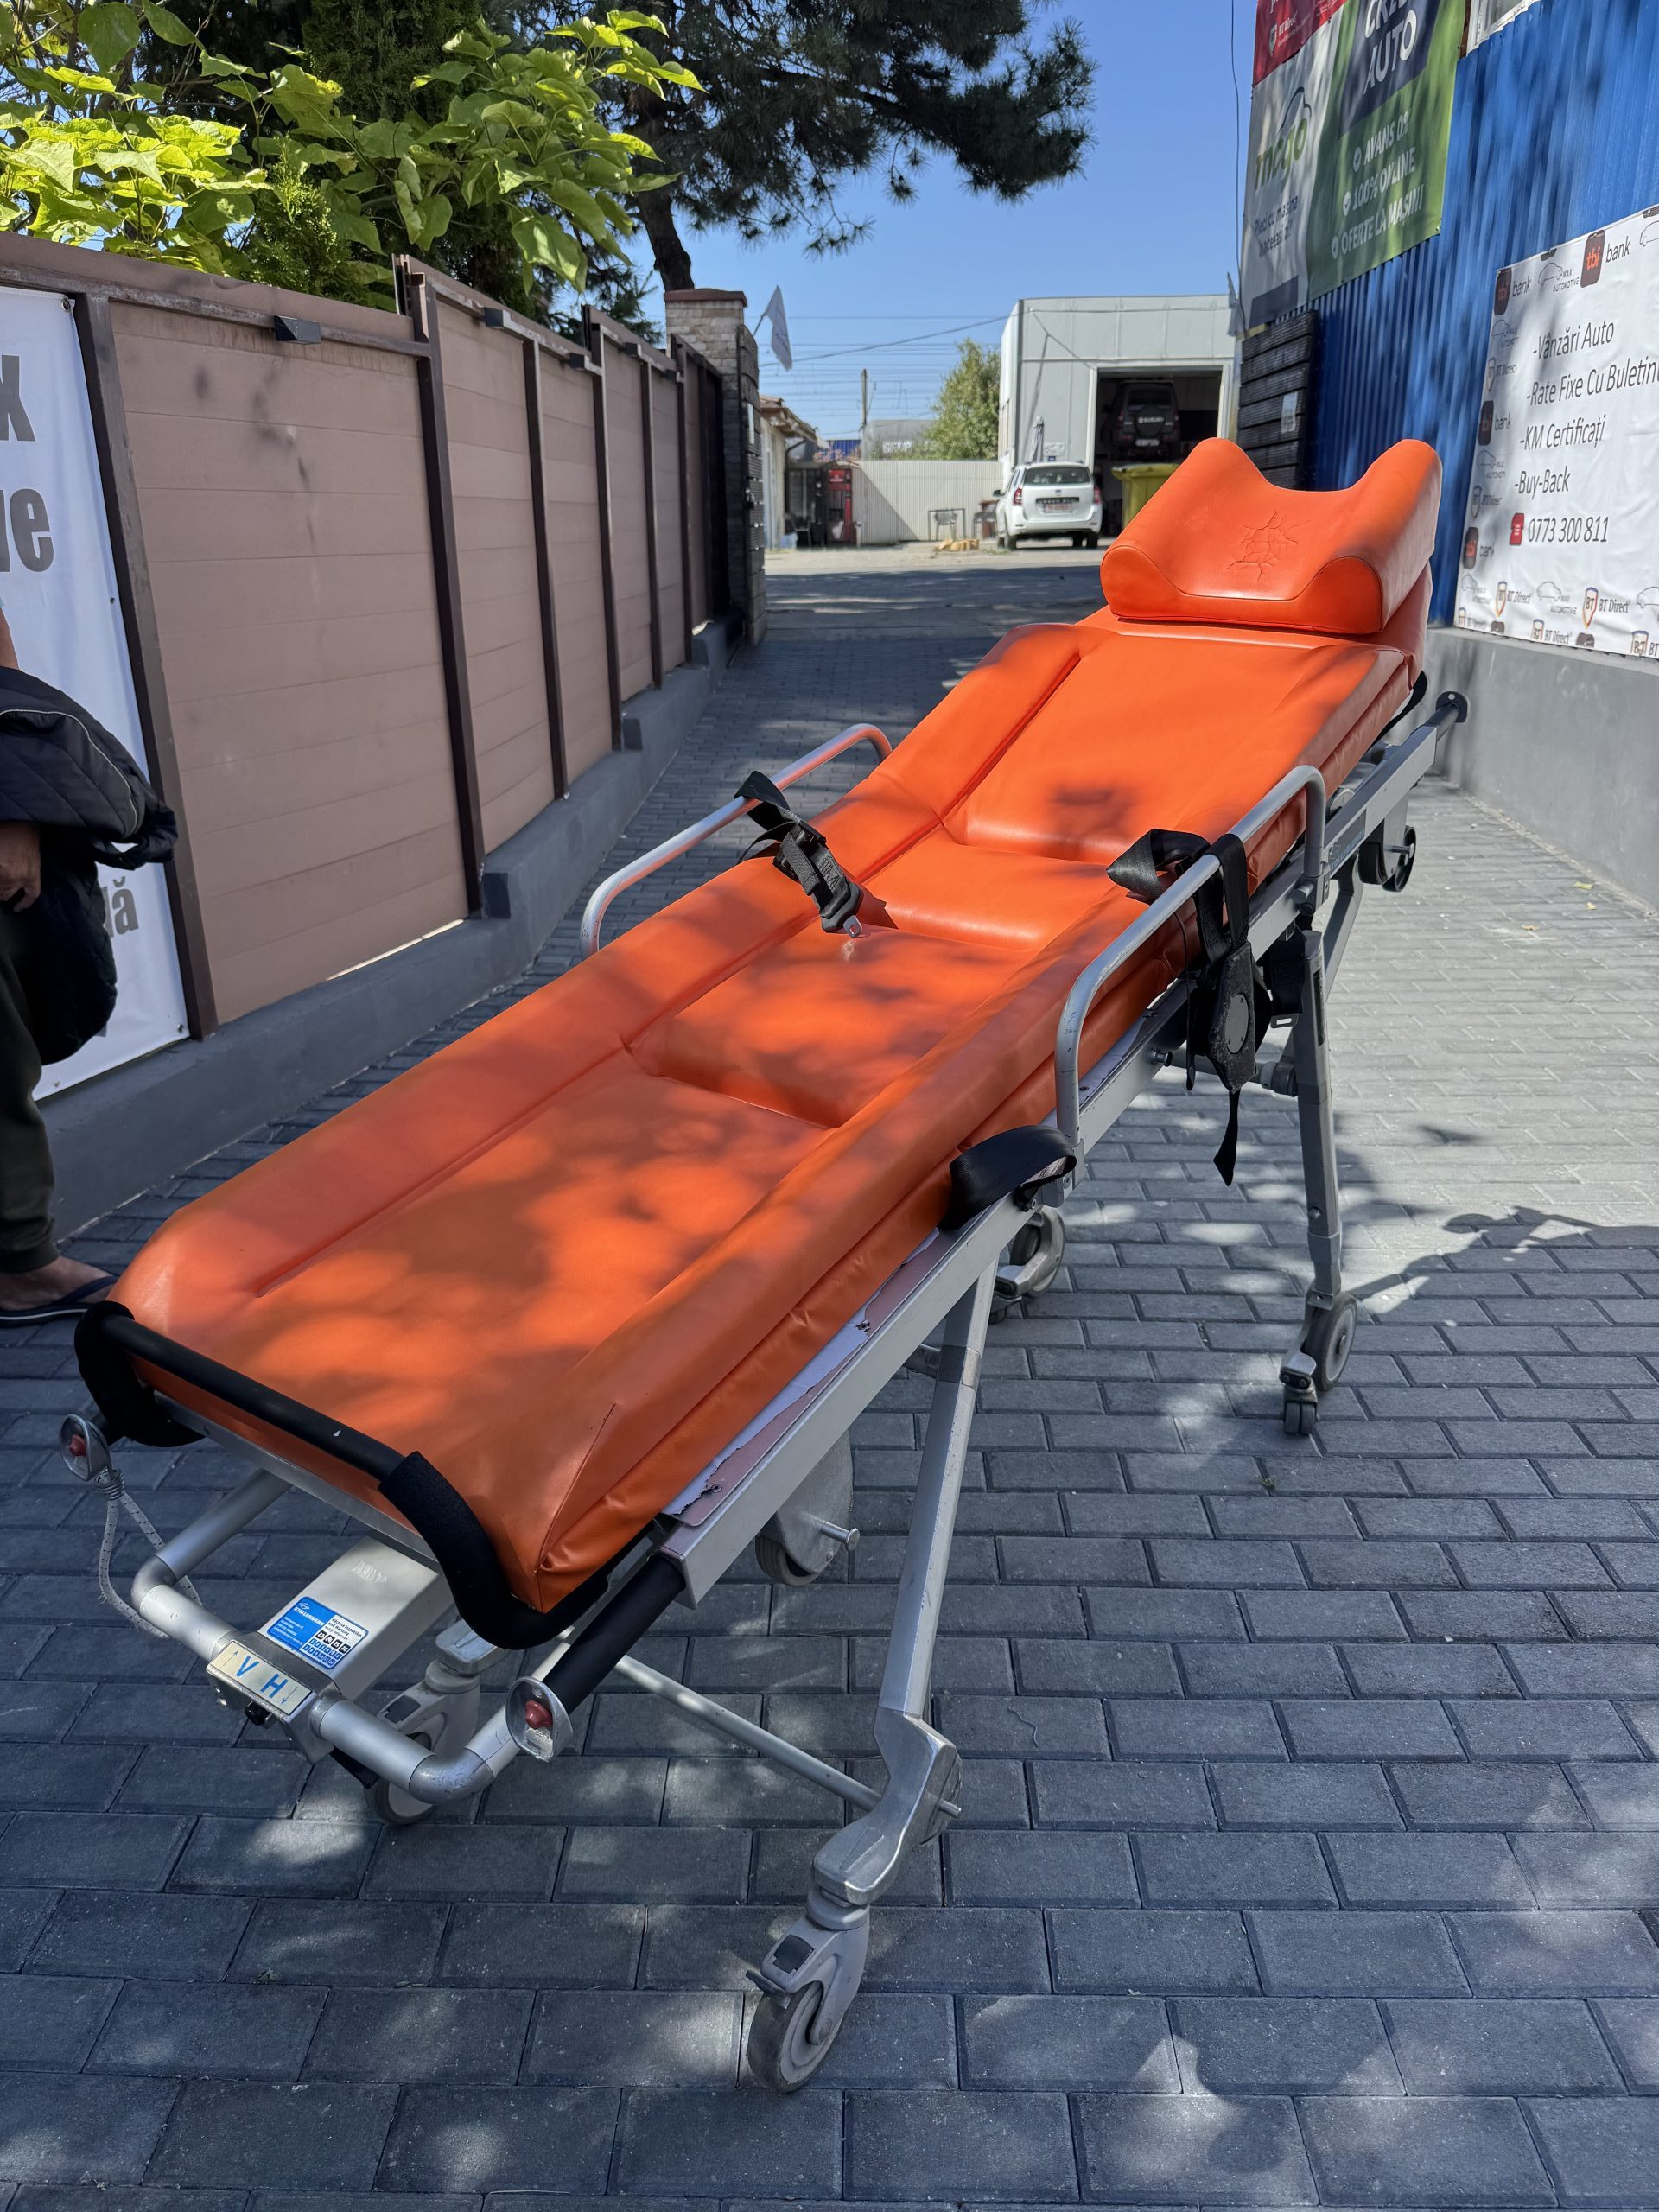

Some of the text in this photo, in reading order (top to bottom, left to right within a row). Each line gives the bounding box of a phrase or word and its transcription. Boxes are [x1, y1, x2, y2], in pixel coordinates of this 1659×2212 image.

[1363, 10, 1417, 95] AUTO
[1363, 121, 1395, 165] AVANS
[1352, 146, 1416, 211] 100% ONLINE
[1341, 215, 1375, 255] OFERTE
[1375, 207, 1387, 236] LA
[1586, 236, 1631, 270] tbi bank
[1512, 275, 1531, 297] bank
[1533, 321, 1614, 359] -Vânzări Auto
[1526, 356, 1659, 406] -Rate Fixe Cu Buletin
[1520, 413, 1606, 450] -KM Certificați
[1514, 465, 1571, 500] -Buy-Back
[1528, 516, 1609, 543] 0773 300 811
[1586, 597, 1595, 610] BT
[1599, 599, 1629, 613] BT Direct
[236, 1656, 289, 1699] V H
